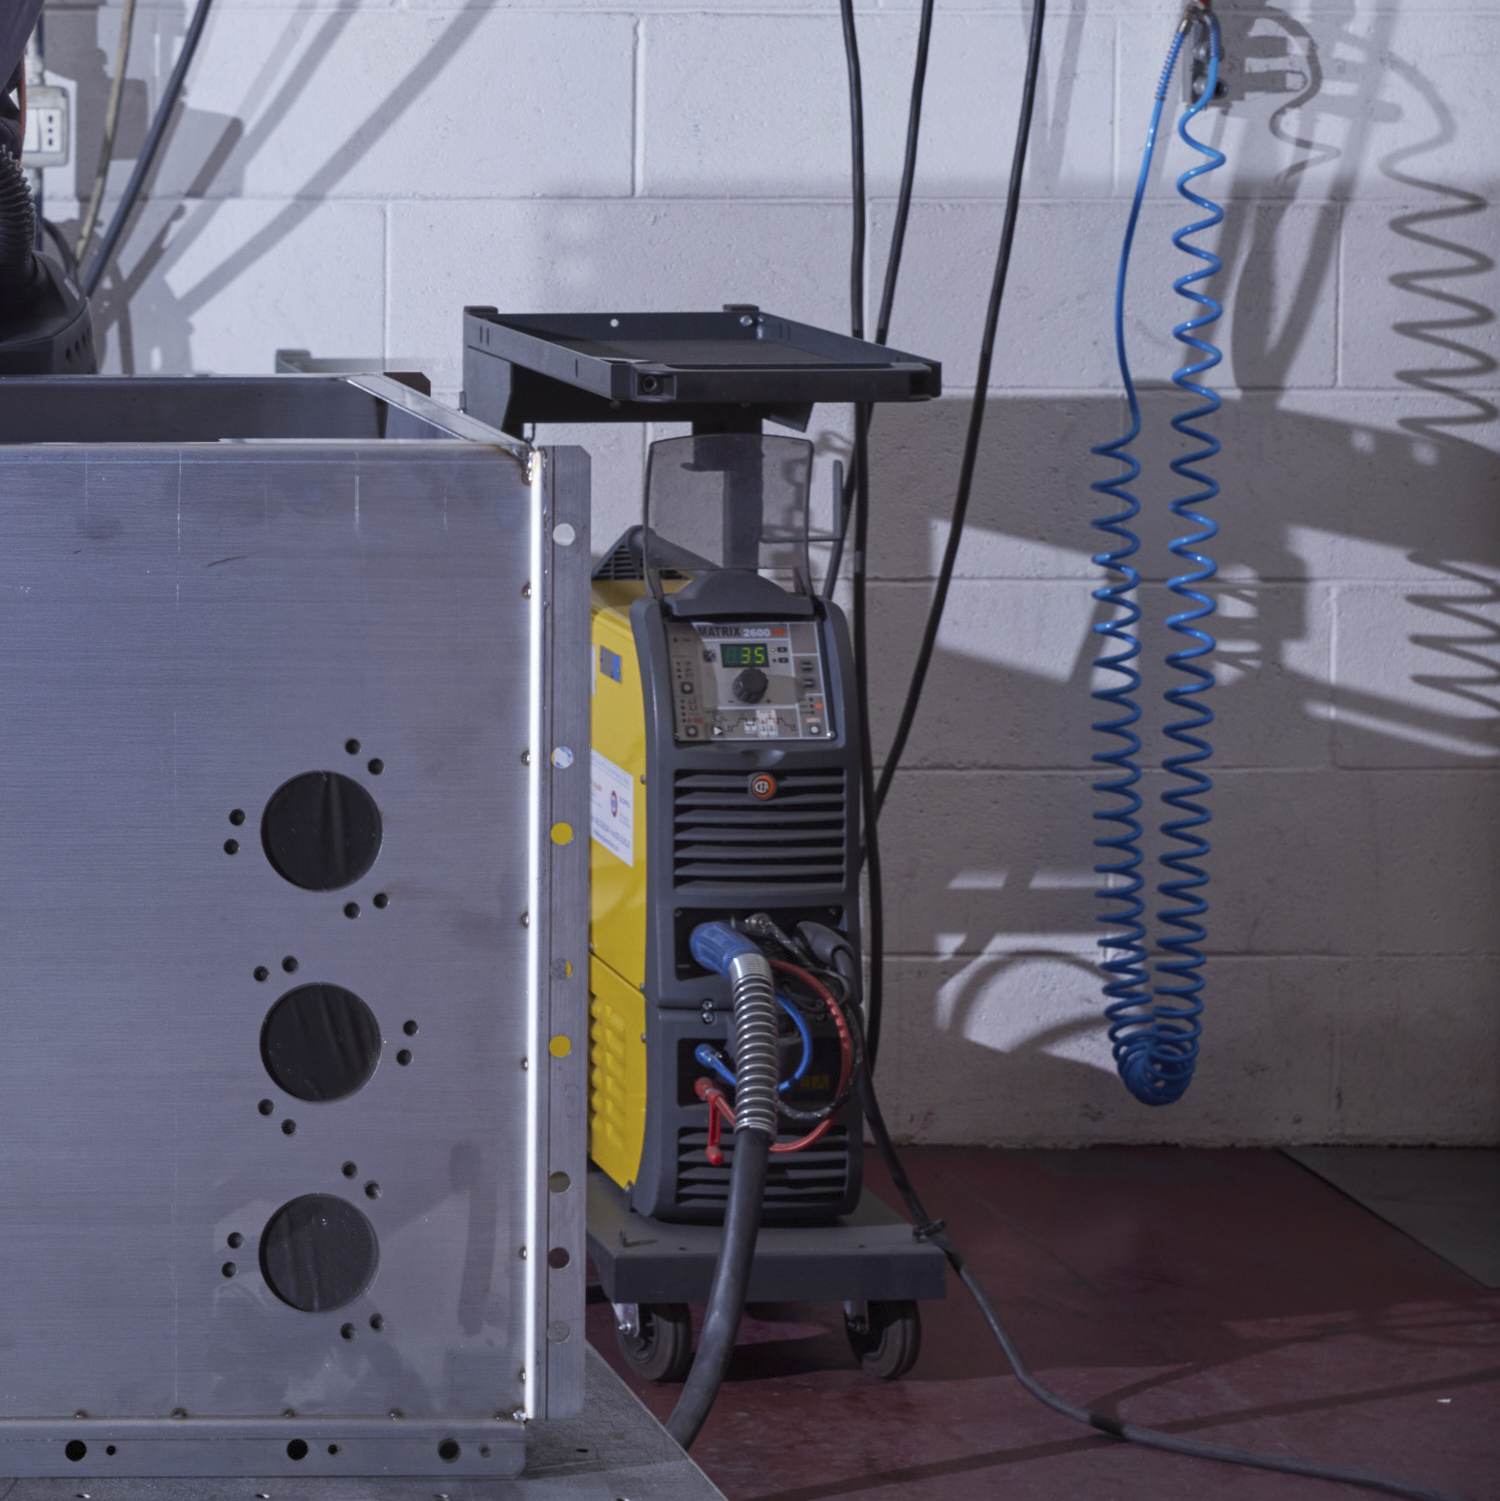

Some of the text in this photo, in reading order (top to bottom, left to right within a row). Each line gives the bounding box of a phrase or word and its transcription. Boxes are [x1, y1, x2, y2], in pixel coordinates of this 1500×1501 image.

[697, 625, 741, 637] MATRIX
[742, 628, 771, 637] 2600
[741, 647, 765, 664] 35
